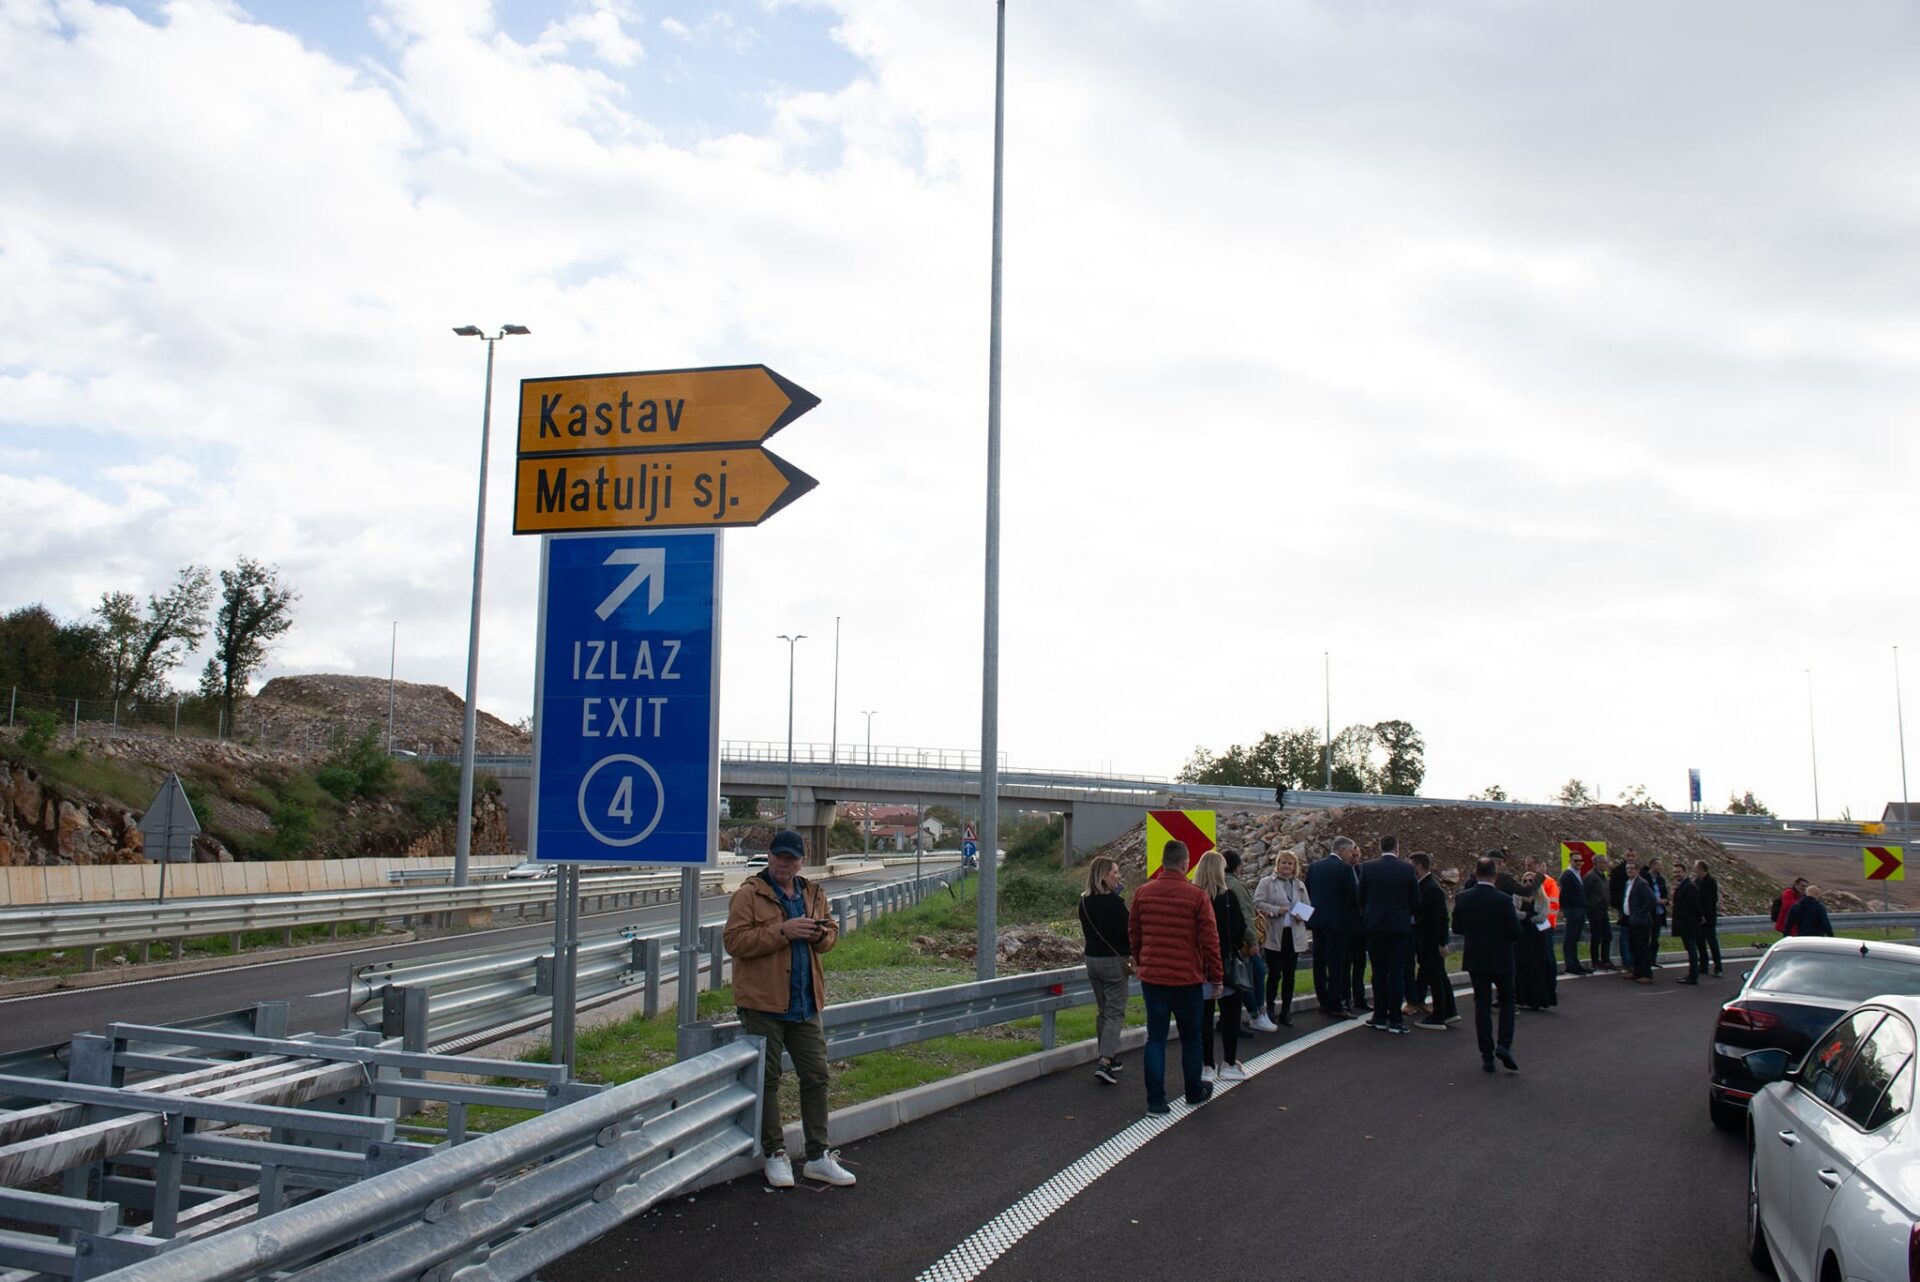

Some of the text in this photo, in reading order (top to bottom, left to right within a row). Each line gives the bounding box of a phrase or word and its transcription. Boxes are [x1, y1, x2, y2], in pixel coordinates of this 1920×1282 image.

[539, 390, 685, 439] Kastav
[535, 460, 739, 522] Matulji sj.
[573, 640, 681, 680] IZLAZ
[582, 697, 668, 737] EXIT
[607, 776, 633, 824] 4
